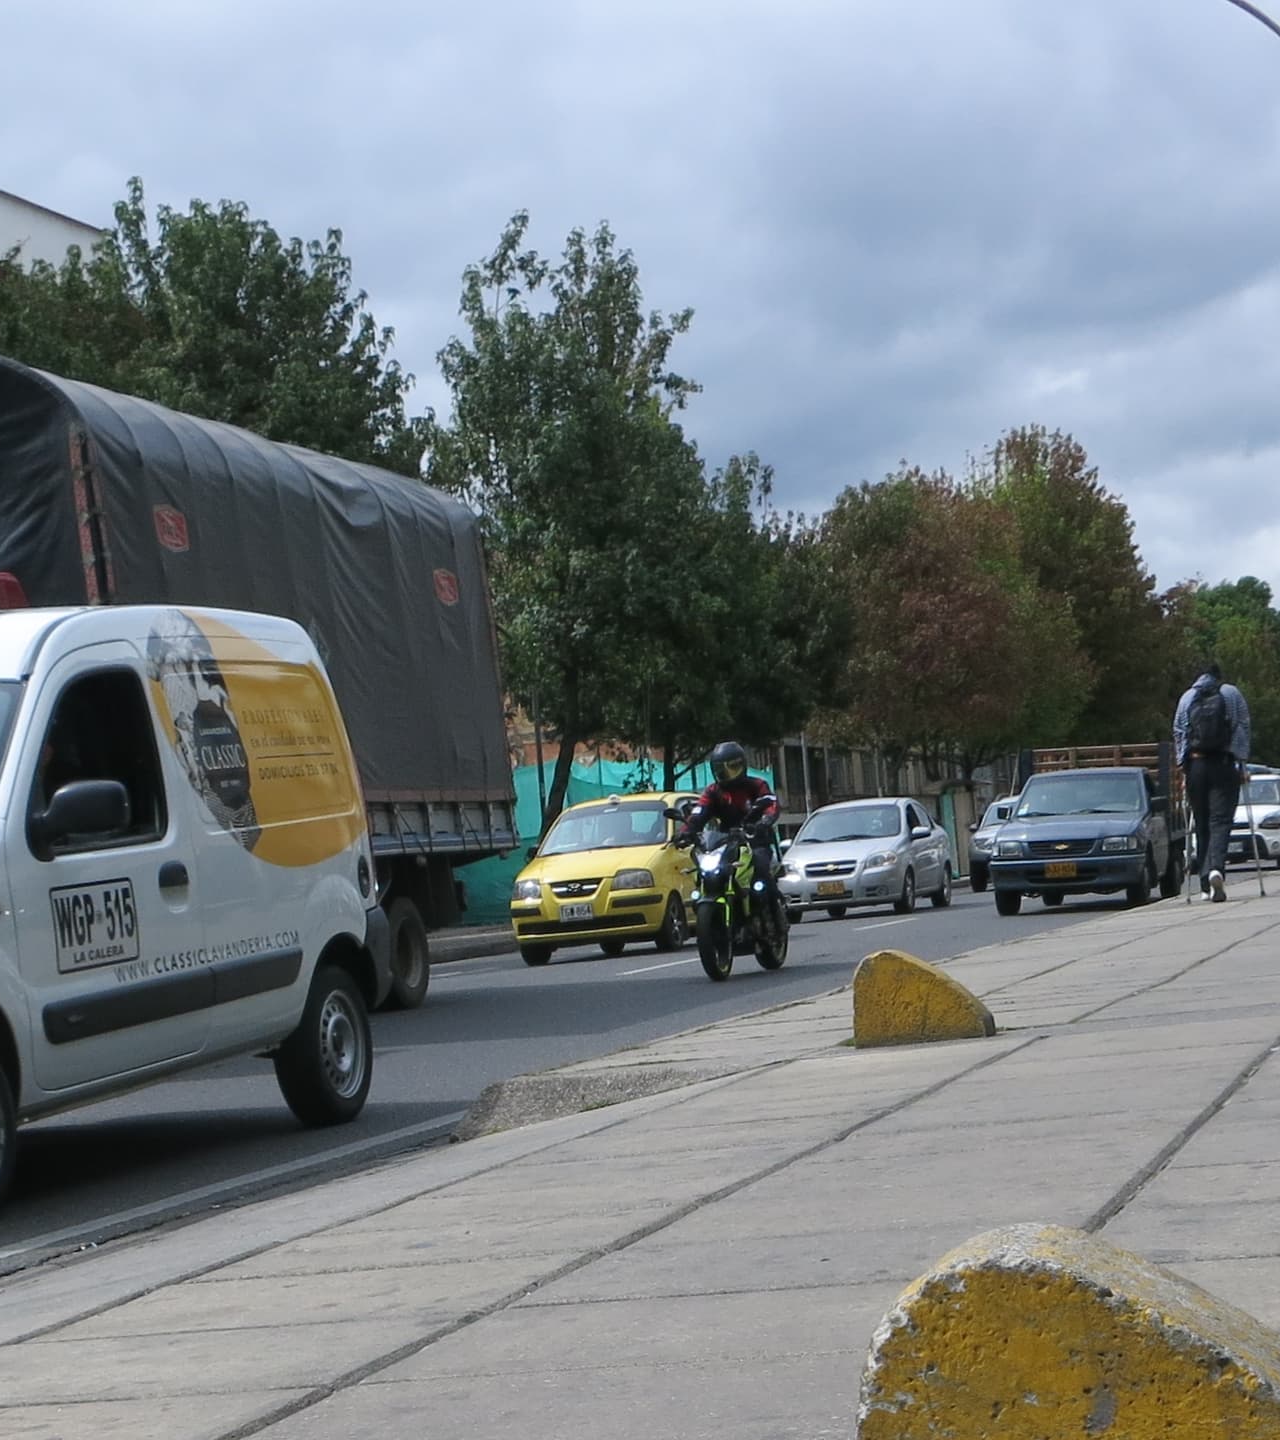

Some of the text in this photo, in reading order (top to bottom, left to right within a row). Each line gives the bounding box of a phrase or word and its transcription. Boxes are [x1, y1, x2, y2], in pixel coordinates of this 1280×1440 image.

[201, 743, 247, 770] CLASSIC
[73, 944, 125, 964] LA CALERA
[113, 930, 301, 982] WWW.CLASSICLAVANDERIA.COM
